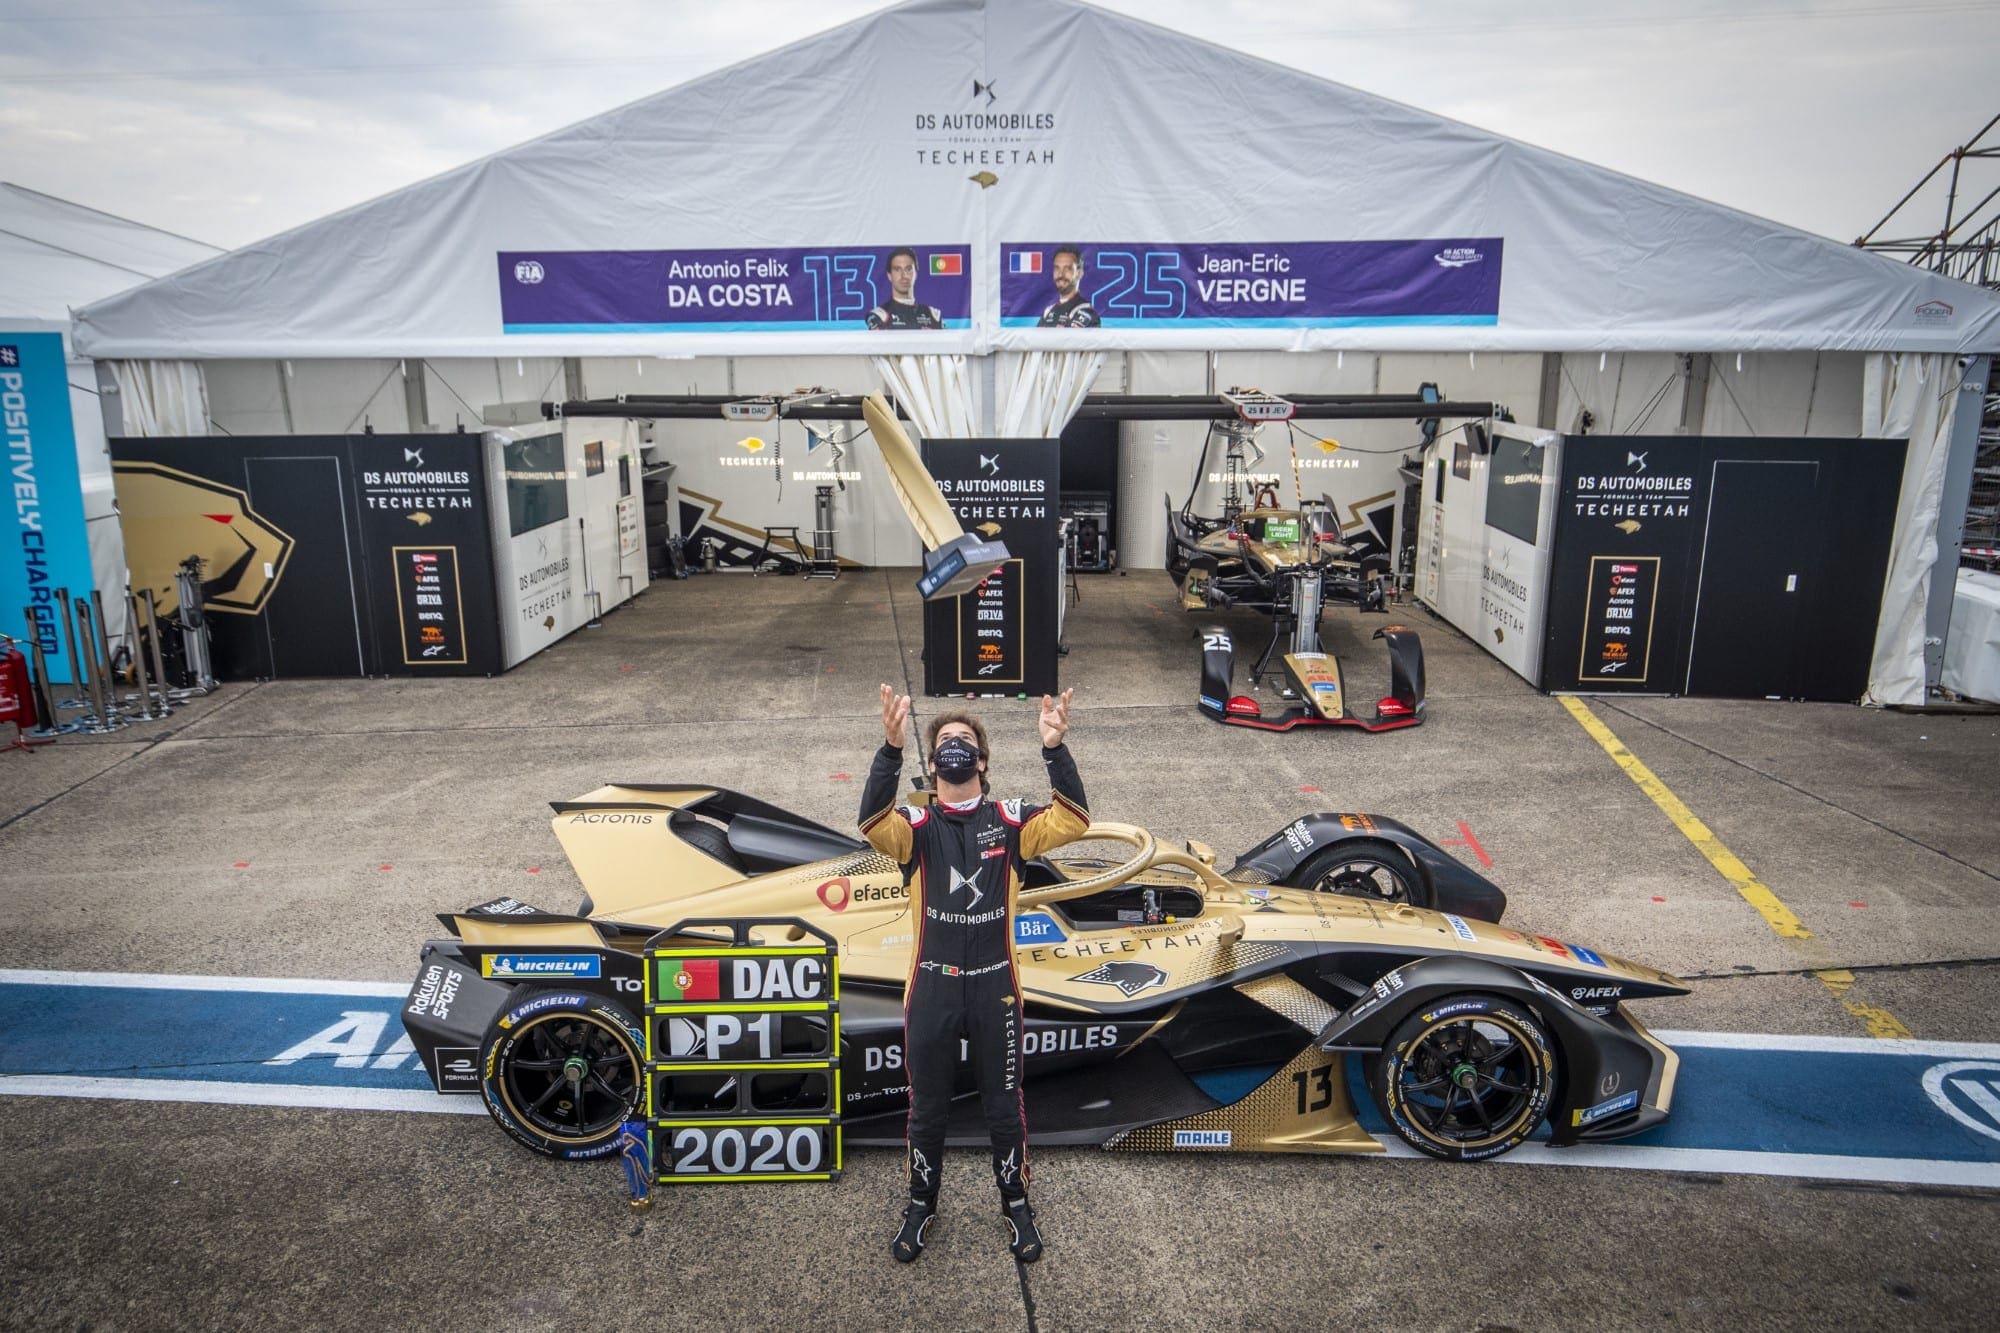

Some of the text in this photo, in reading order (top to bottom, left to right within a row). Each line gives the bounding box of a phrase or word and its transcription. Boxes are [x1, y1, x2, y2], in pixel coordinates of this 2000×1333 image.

[916, 114, 1055, 130] DS AUTOMOBILES
[917, 150, 1055, 165] TECHEETAH
[516, 266, 544, 281] FIA
[668, 258, 789, 279] Antonio Felix
[1197, 253, 1290, 275] Jean-Eric
[803, 254, 878, 323] 13
[1091, 251, 1187, 319] 25
[1198, 278, 1307, 304] VERGNE
[668, 283, 794, 308] DA COSTA
[751, 407, 767, 415] DAC
[1272, 406, 1287, 415] JEV
[719, 457, 785, 467] TECHEETAH
[363, 471, 470, 485] DS AUTOMOBILES
[956, 479, 1046, 493] AUTOMOBILES
[1577, 476, 1693, 491] DS AUTOMOBILES
[366, 497, 473, 509] TECHEETAH
[1575, 503, 1690, 517] TECHEETAH
[529, 558, 569, 588] AUTOMOBILES
[1491, 570, 1527, 602] AUTOMOBILES
[522, 588, 572, 621] TECHEETAH
[1481, 597, 1525, 635] TECHEETAH
[1203, 634, 1232, 653] 25
[570, 812, 654, 825] Acronis
[854, 884, 910, 902] efacec
[926, 906, 1006, 925] DS AUTOMOBILES
[1019, 921, 1051, 937] Bär
[515, 961, 590, 972] MICHELIN
[733, 957, 821, 1000] DAC
[408, 965, 444, 1015] Rakuten
[432, 969, 463, 1020] SPORTS
[1586, 986, 1623, 999] AFEX
[519, 996, 581, 1017] MICHELIN
[1438, 1002, 1484, 1016] MICHELIN
[706, 1013, 771, 1060] P1
[865, 1045, 903, 1072] DS
[1004, 1009, 1017, 1091] TECHEETAH
[847, 1092, 862, 1101] DS
[1293, 1064, 1333, 1115] 13
[1176, 1132, 1229, 1145] MAHLE
[674, 1126, 822, 1175] 2020
